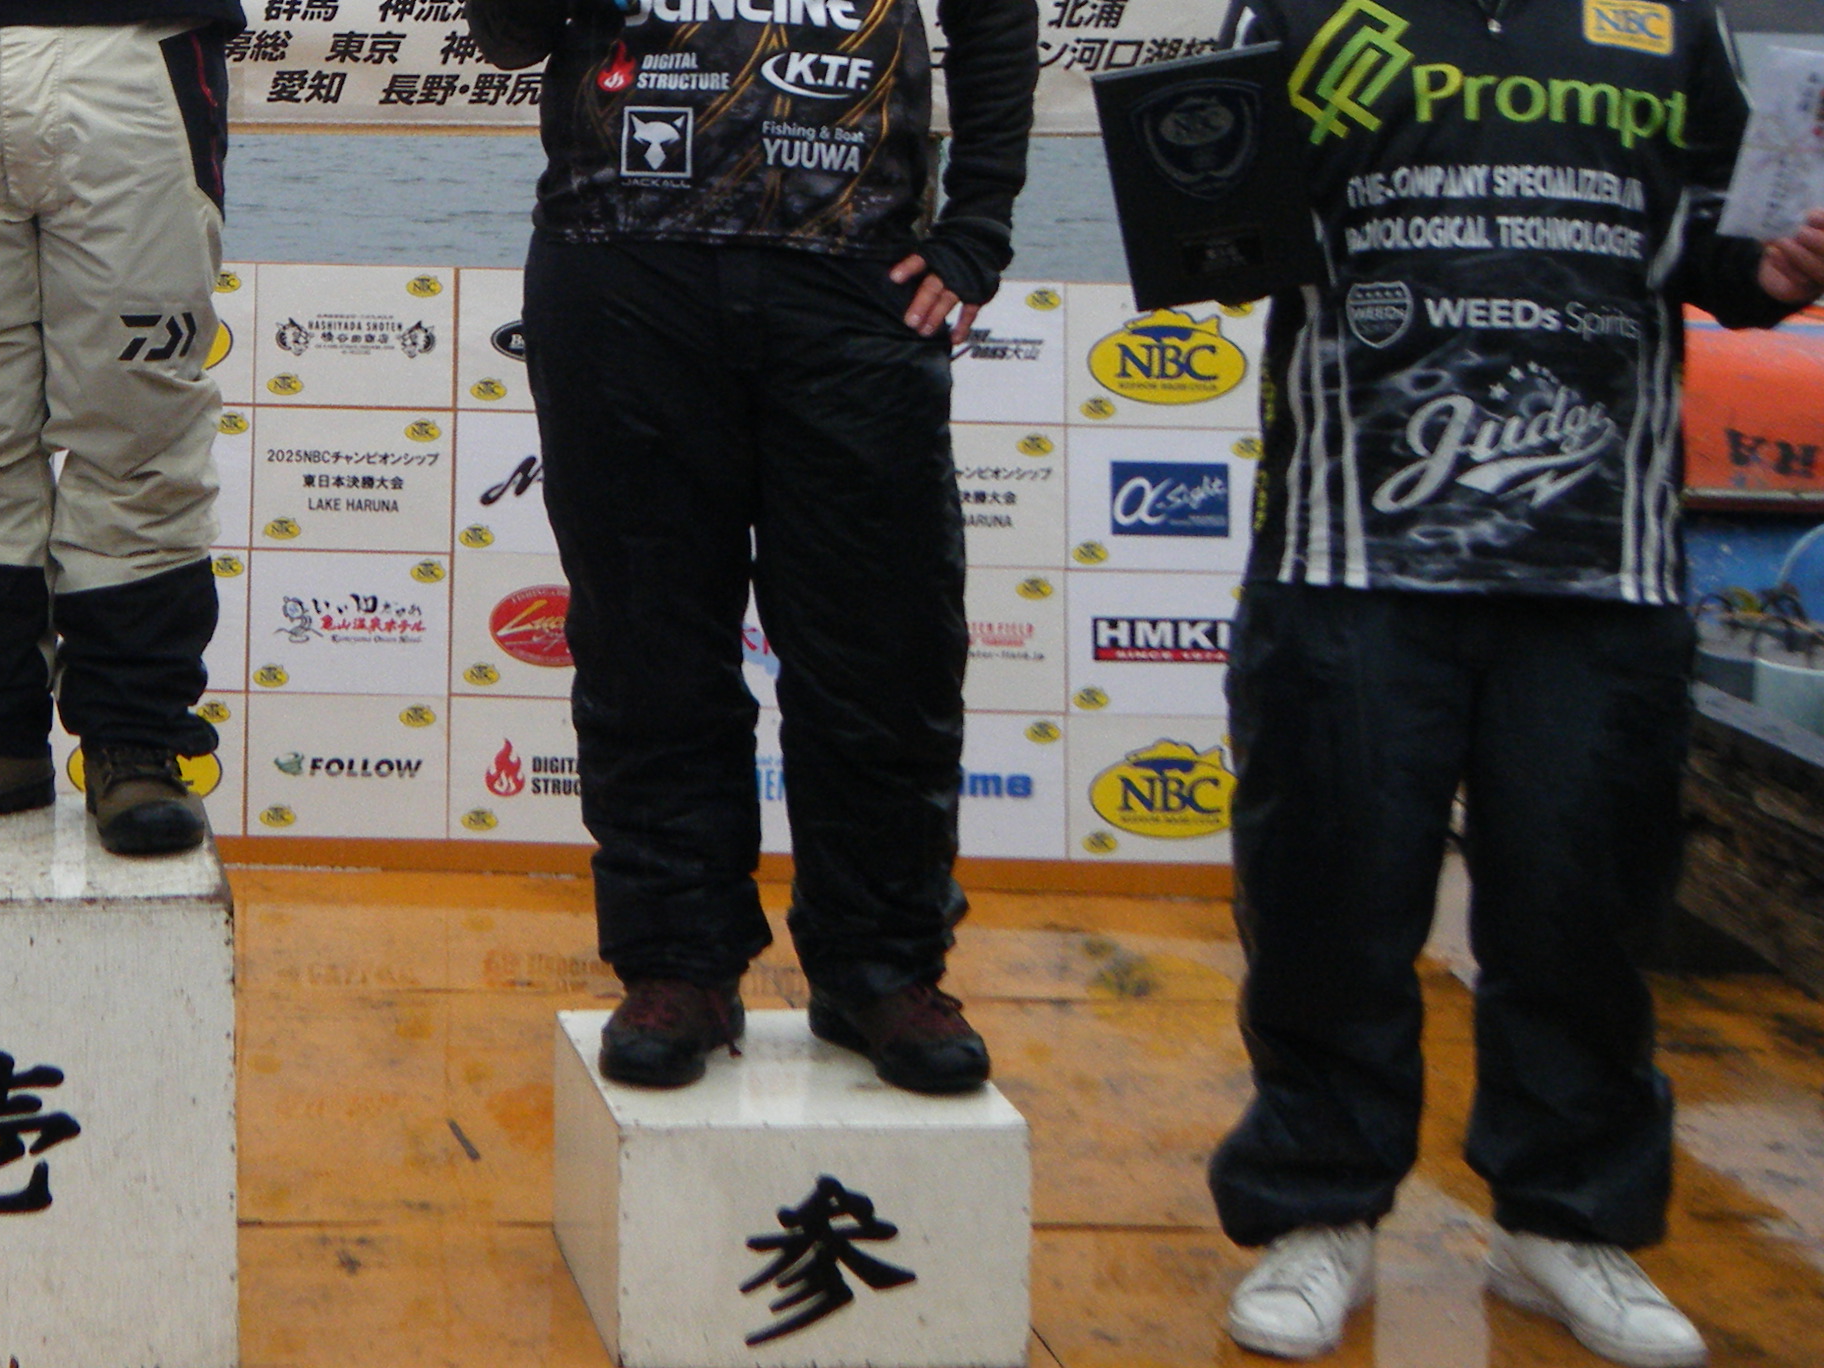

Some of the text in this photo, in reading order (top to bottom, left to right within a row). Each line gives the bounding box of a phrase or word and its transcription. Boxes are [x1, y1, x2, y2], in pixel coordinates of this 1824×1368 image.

[1592, 7, 1664, 40] NBC
[326, 31, 407, 64] 東京
[440, 31, 492, 66] 神
[641, 52, 699, 70] DIGITAL
[266, 69, 347, 104] 愛知
[637, 72, 731, 91] STRUCTURE
[784, 51, 874, 91] K.T.F.
[1412, 63, 1688, 150] Prompt
[762, 121, 866, 144] Fishing & Boat
[762, 138, 861, 173] YUUWA
[1424, 296, 1562, 332] WEEDs
[1114, 343, 1219, 382] NBC
[266, 448, 440, 466] 2025NBCチャンピオンシップ
[302, 473, 405, 490] 東日本決勝大会
[308, 497, 400, 513] LAKE HARUNA
[309, 757, 424, 778] FOLLOW
[532, 756, 577, 774] DIGIT
[1118, 776, 1223, 815] NBC
[738, 1173, 918, 1346] 参
